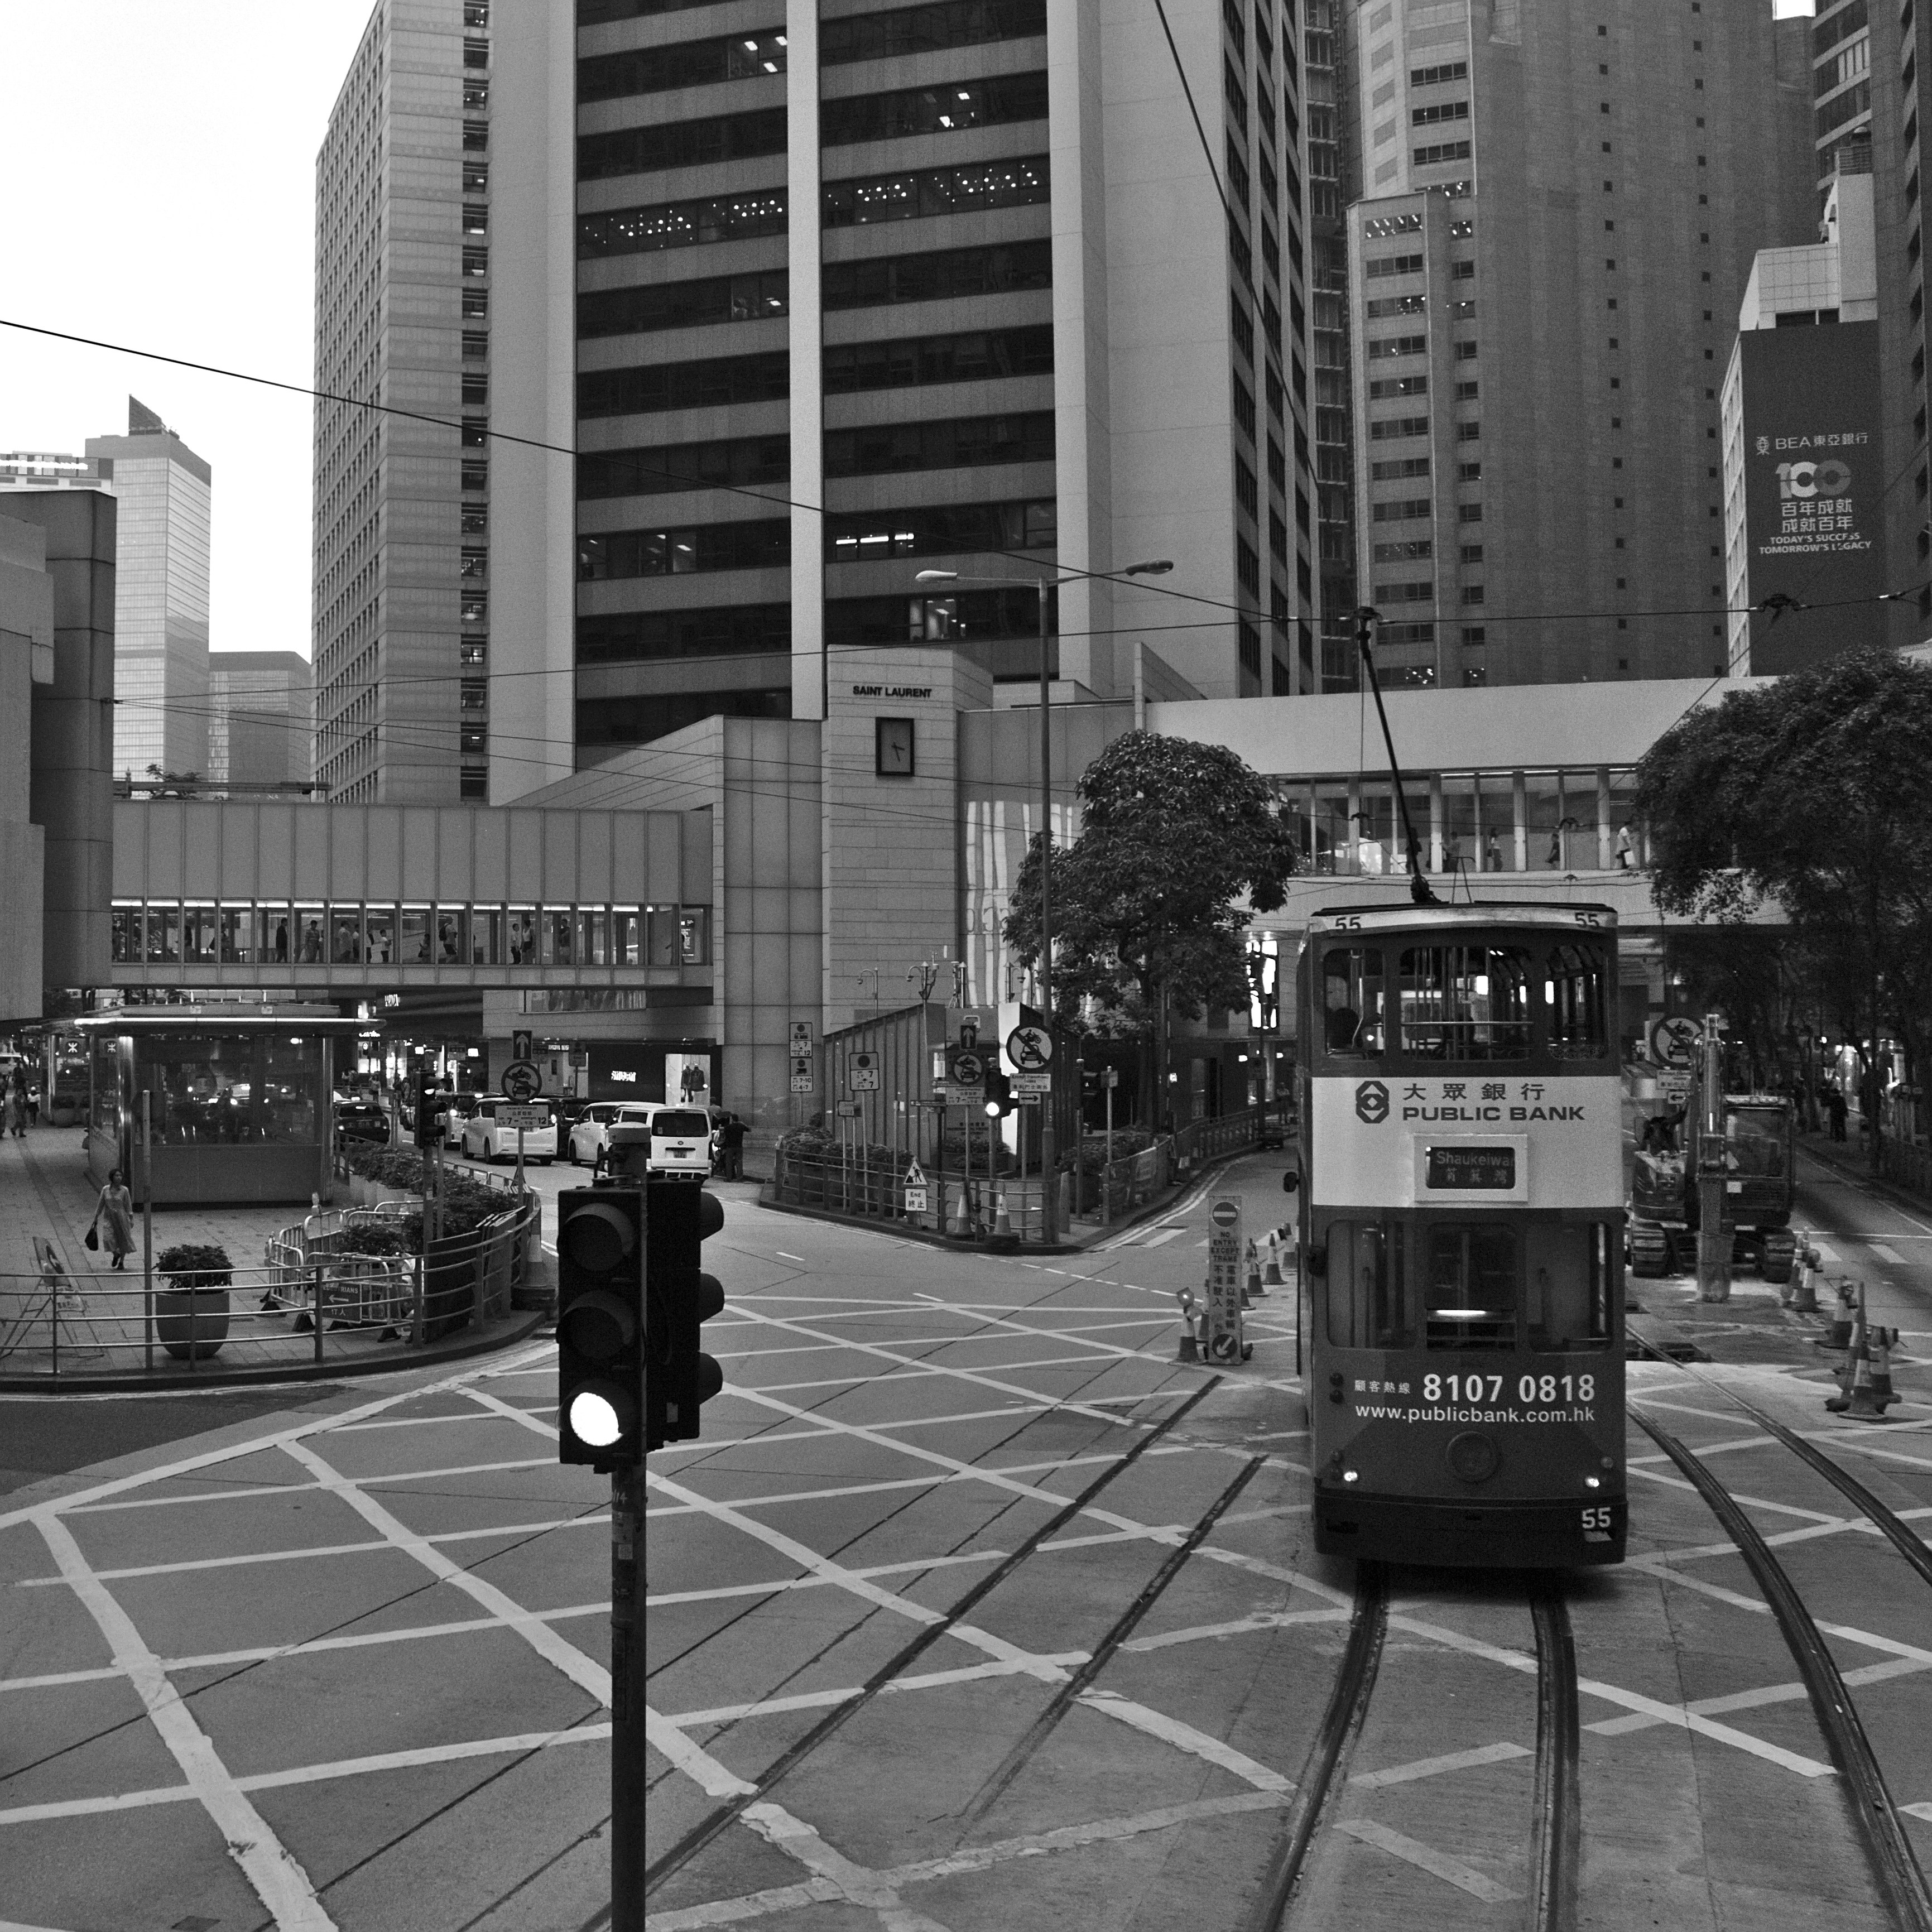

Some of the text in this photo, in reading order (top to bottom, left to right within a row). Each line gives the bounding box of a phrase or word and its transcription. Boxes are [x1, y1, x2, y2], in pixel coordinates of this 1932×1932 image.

[1775, 432, 1868, 450] BEA 東亞銀行
[1781, 498, 1853, 517] 百年成就
[1781, 516, 1853, 534] 成就百年
[1770, 535, 1813, 545] TODAY'S
[1758, 544, 1829, 555] TOMORROW'S
[853, 685, 932, 698] SAINT LAURENT
[1335, 917, 1361, 932] 55
[1574, 912, 1600, 929] 55
[1403, 1083, 1545, 1102] 大眾銀行
[1402, 1106, 1585, 1121] PUBLIC BANK
[1423, 1374, 1595, 1402] 8107 0818
[1355, 1405, 1595, 1424] www.publicbank.com.hk
[1582, 1507, 1611, 1529] 55
